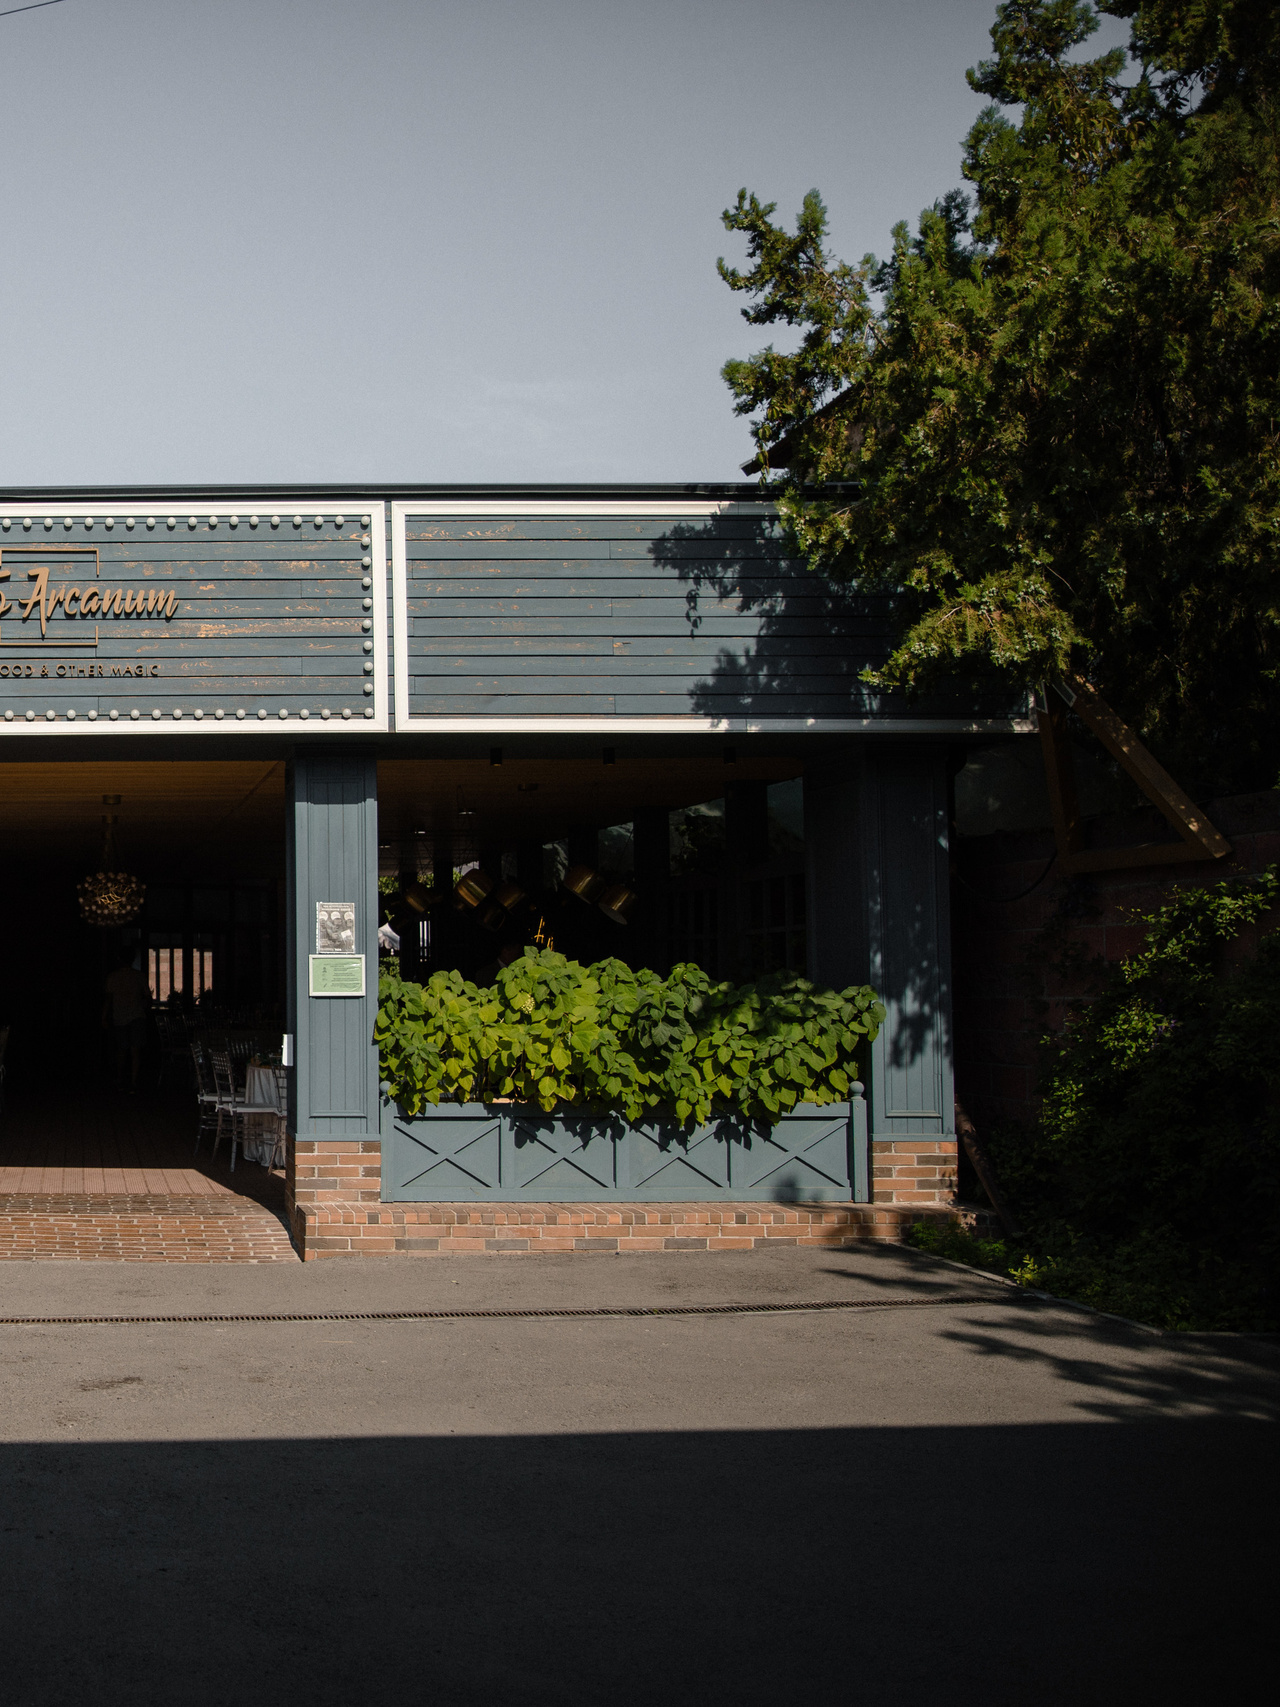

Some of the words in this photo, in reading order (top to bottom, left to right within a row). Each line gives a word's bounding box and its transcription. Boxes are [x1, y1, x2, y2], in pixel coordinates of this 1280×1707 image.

[19, 566, 180, 636] Arcanum
[40, 664, 49, 676] &
[56, 664, 104, 676] OTHER
[110, 664, 159, 676] MAGIC
